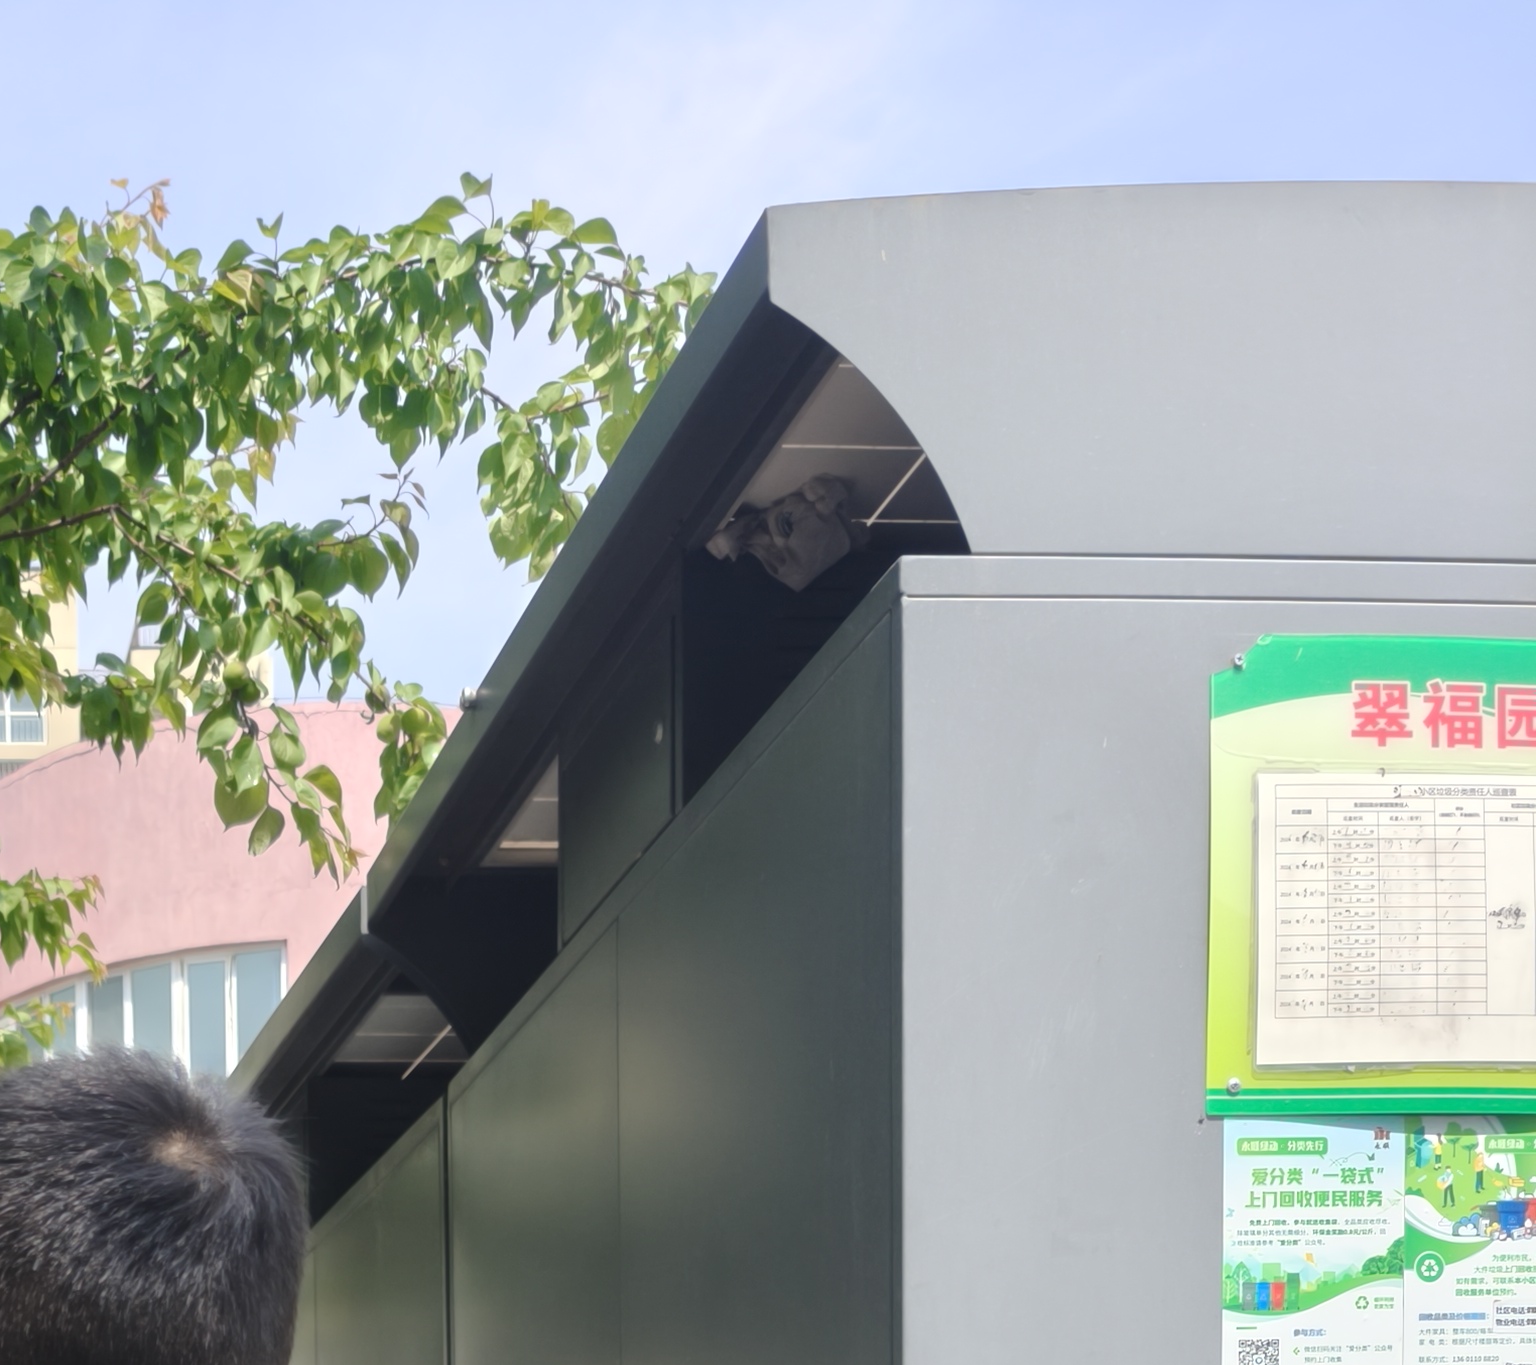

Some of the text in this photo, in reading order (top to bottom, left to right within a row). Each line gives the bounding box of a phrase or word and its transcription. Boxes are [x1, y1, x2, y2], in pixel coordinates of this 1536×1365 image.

[1351, 679, 1536, 749] 翠福园
[1245, 1189, 1383, 1208] 上门回收便民服务
